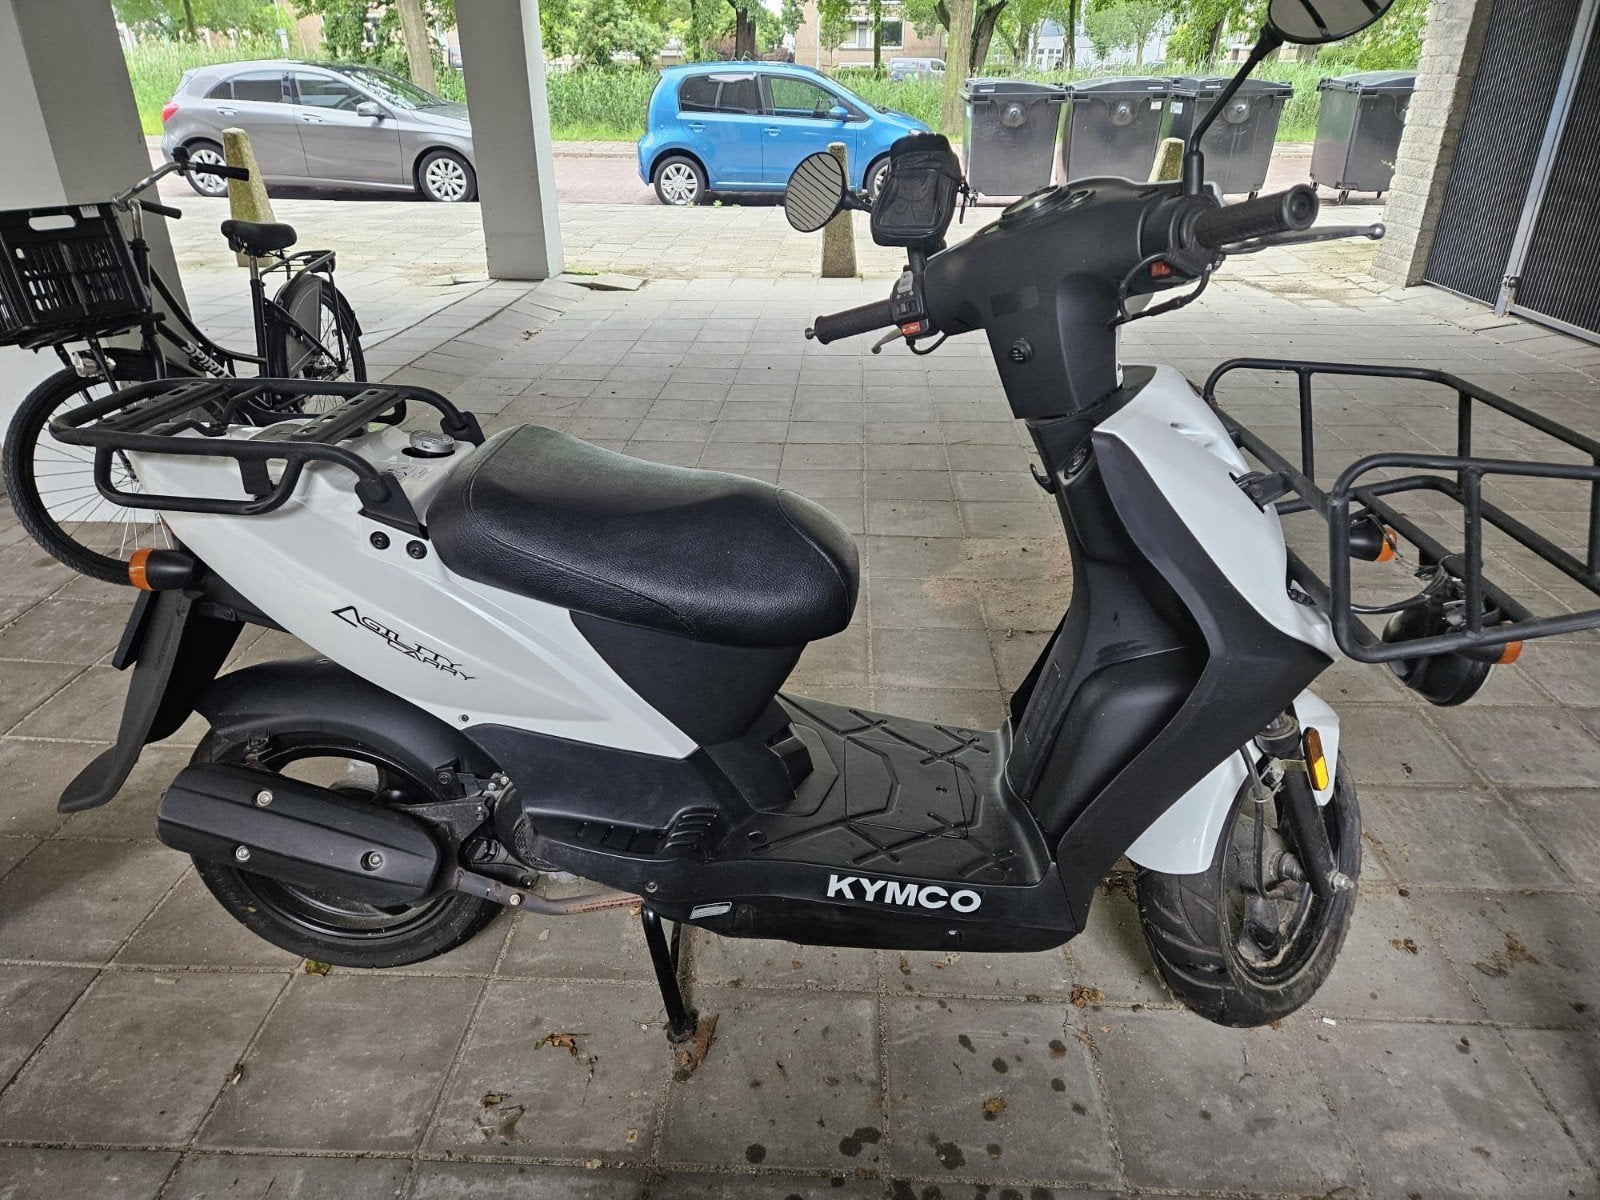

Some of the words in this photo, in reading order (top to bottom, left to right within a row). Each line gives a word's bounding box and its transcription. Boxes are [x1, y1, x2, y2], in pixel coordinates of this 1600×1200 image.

[331, 605, 463, 668] AGILITY
[387, 639, 477, 680] CARRY
[826, 874, 982, 913] KYMCO
